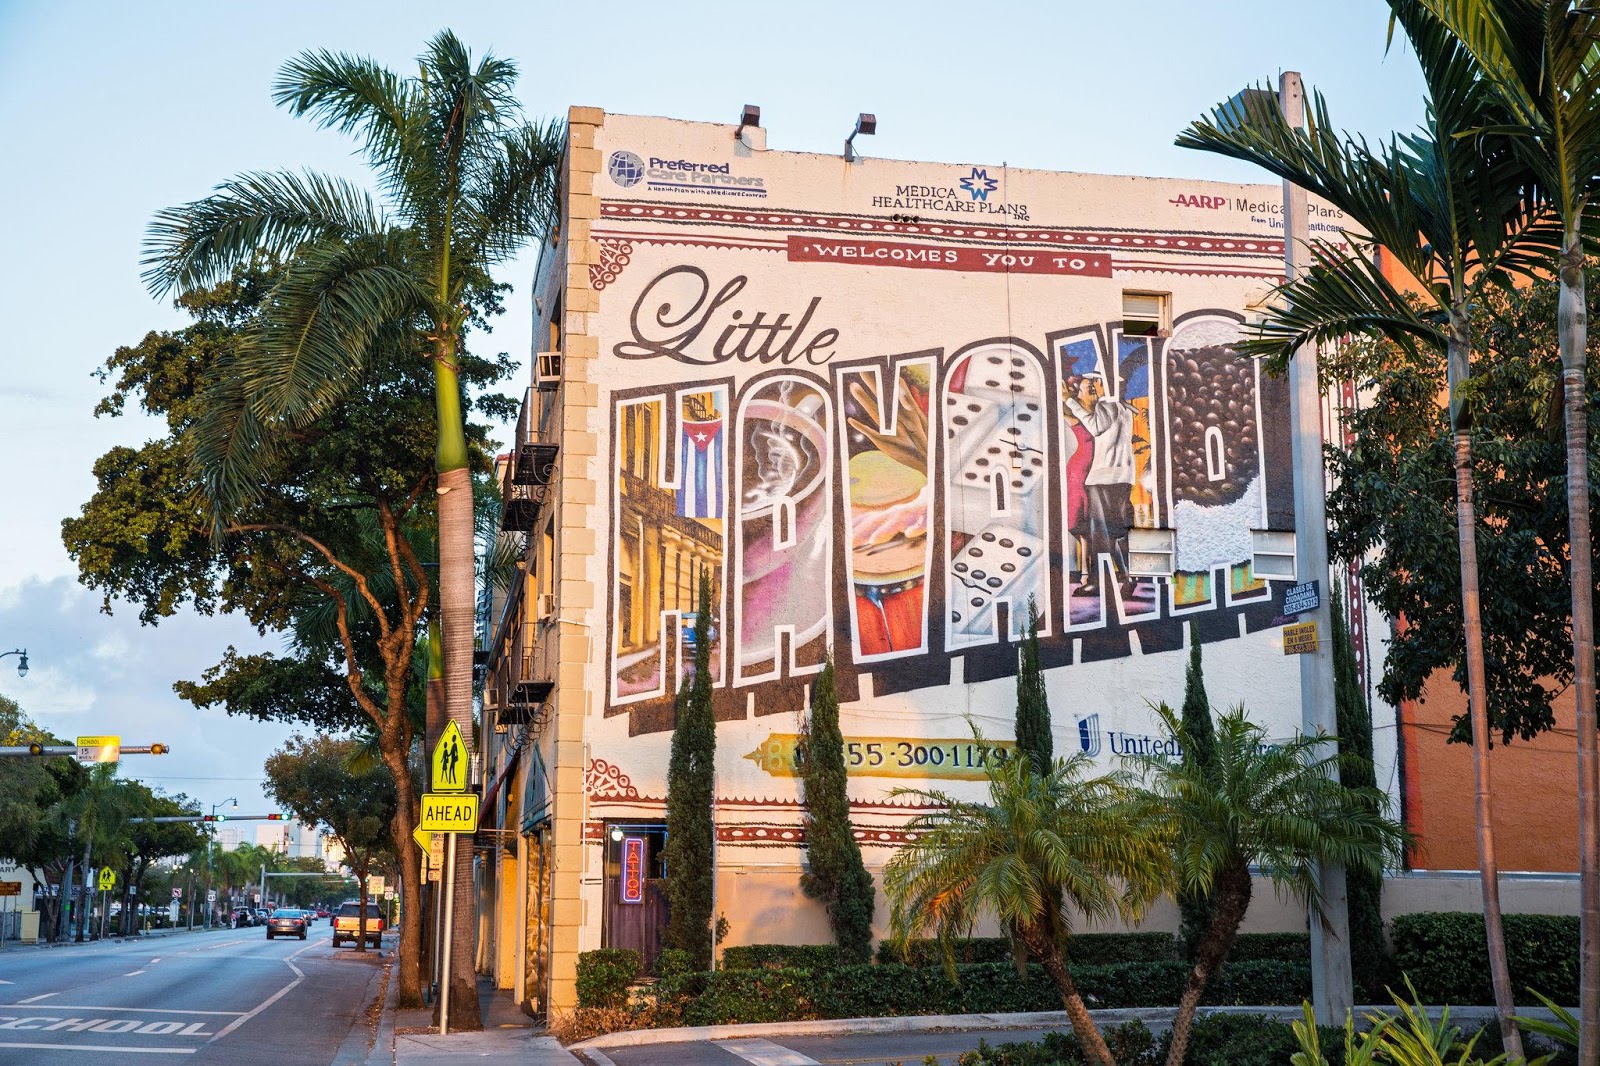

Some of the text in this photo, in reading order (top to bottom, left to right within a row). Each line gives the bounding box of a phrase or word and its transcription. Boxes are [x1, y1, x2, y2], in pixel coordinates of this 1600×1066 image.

[649, 157, 730, 175] Preferred
[647, 168, 764, 187] Care Partners
[741, 191, 768, 199] Contract
[896, 185, 958, 200] MEDICA
[871, 196, 1028, 216] HEALTHCARE PLANS
[1169, 193, 1226, 210] AARP
[1307, 204, 1344, 219] Plans
[1013, 213, 1030, 222] INC
[812, 243, 1086, 270] WELCOMES YOU TO
[612, 264, 840, 366] Little
[604, 308, 1275, 716] HAVANA
[1286, 582, 1313, 596] CLASES DE
[425, 805, 472, 821] AHEAD
[627, 841, 640, 899] TATTOO
